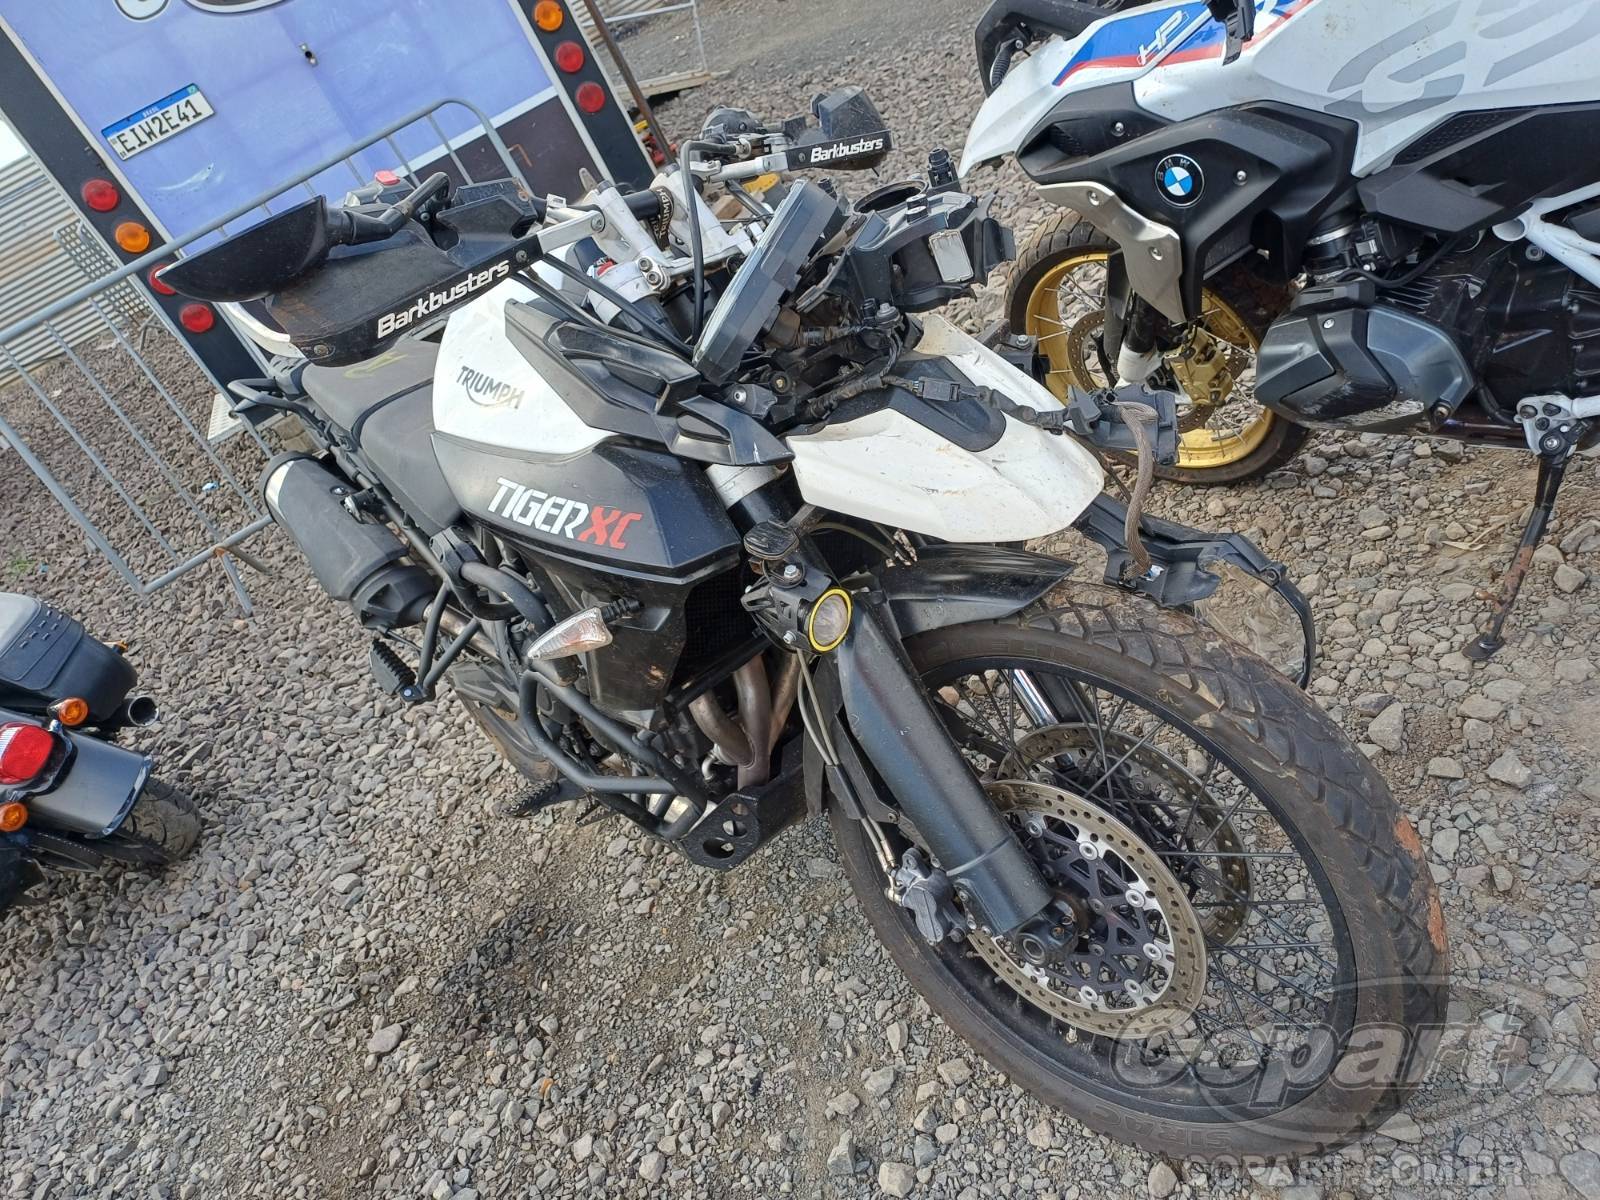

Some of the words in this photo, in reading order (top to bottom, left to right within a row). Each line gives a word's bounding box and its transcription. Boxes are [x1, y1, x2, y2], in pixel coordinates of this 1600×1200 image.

[117, 99, 202, 153] EIW2E41
[811, 138, 883, 163] Barkbusters
[1157, 158, 1190, 181] BMW
[377, 259, 510, 339] Barkbusters
[456, 365, 525, 410] TRIUMPH
[487, 476, 589, 539] TIGER
[577, 504, 643, 550] XC
